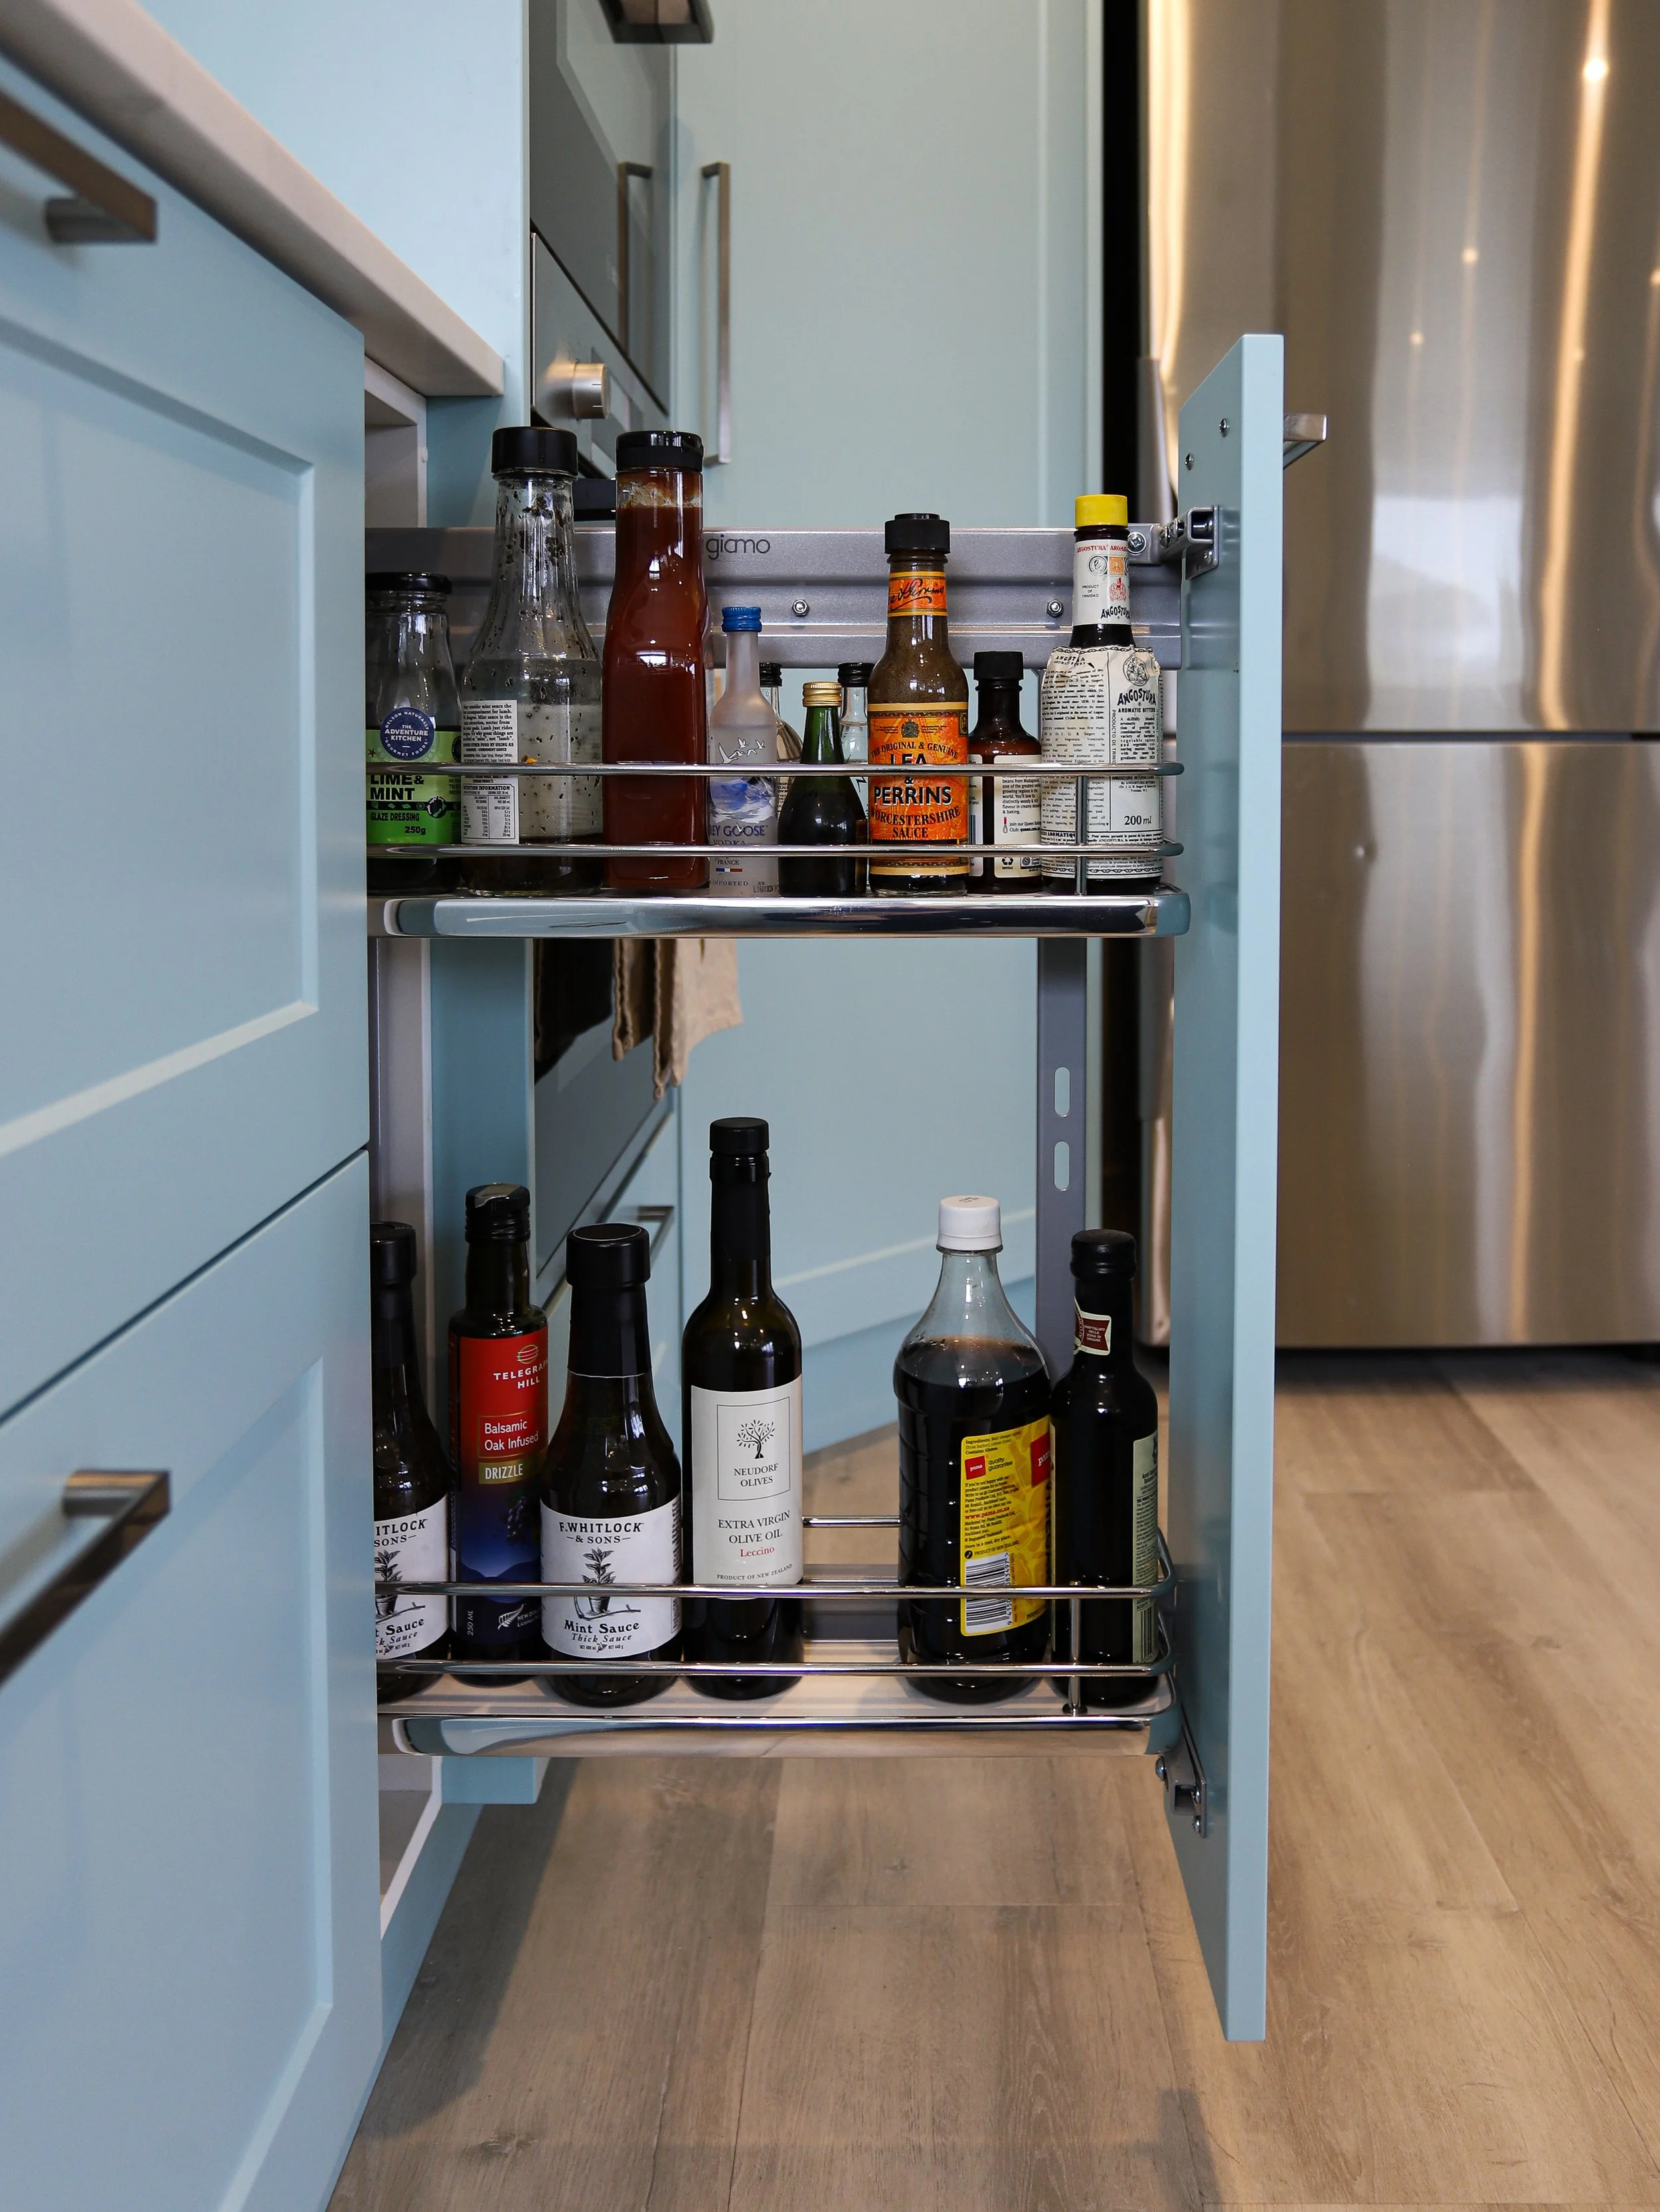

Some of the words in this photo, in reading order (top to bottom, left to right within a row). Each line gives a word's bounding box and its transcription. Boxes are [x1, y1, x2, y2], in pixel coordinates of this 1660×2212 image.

[1117, 688, 1156, 705] ANGOSTURA
[385, 712, 402, 728] NELSON
[404, 711, 430, 730] NATURALLY
[385, 739, 409, 756] GOURMET
[412, 740, 428, 756] FOODS
[871, 746, 880, 758] THE
[882, 741, 916, 753] ORIGINAL
[927, 742, 958, 759] GENUINE
[904, 776, 914, 784] &
[370, 787, 416, 801] MINT
[874, 786, 953, 806] PERRINS
[370, 812, 389, 821] GLAZE
[390, 812, 420, 821] DRESSING
[871, 806, 961, 825] WORCESTERSHIRE
[1124, 815, 1142, 825] 200
[1143, 815, 1152, 825] ml
[404, 825, 426, 835] 250g
[709, 825, 720, 836] EY
[723, 824, 766, 837] GOOSE
[892, 827, 929, 838] SAUCE
[493, 1359, 548, 1381] TELEGRA
[517, 1376, 540, 1389] HILL
[484, 1419, 527, 1434] Balsamic
[484, 1439, 505, 1451] Oak
[507, 1431, 539, 1450] Infused
[1038, 1450, 1051, 1466] pam
[485, 1463, 523, 1480] DRIZZLE
[734, 1463, 778, 1476] NEUDORF
[989, 1461, 1013, 1472] guarantee
[740, 1476, 773, 1488] OLIVES
[718, 1519, 754, 1529] EXTRA
[756, 1510, 790, 1527] VIRGIN
[375, 1519, 426, 1536] ITLOCK
[559, 1522, 642, 1533] F.WHITLOCK
[374, 1535, 407, 1547] SONS
[587, 1535, 621, 1544] SONS
[728, 1533, 762, 1544] OLIVE
[764, 1528, 782, 1541] OIL
[740, 1546, 775, 1557] Leccino
[771, 1563, 793, 1576] ZEALAND
[467, 1610, 473, 1620] ML
[385, 1618, 424, 1636] Sauce
[564, 1620, 593, 1634] Mint
[599, 1622, 639, 1634] Sauce
[390, 1632, 418, 1644] Sauce
[572, 1633, 598, 1643] Thick
[602, 1634, 632, 1643] Sauce
